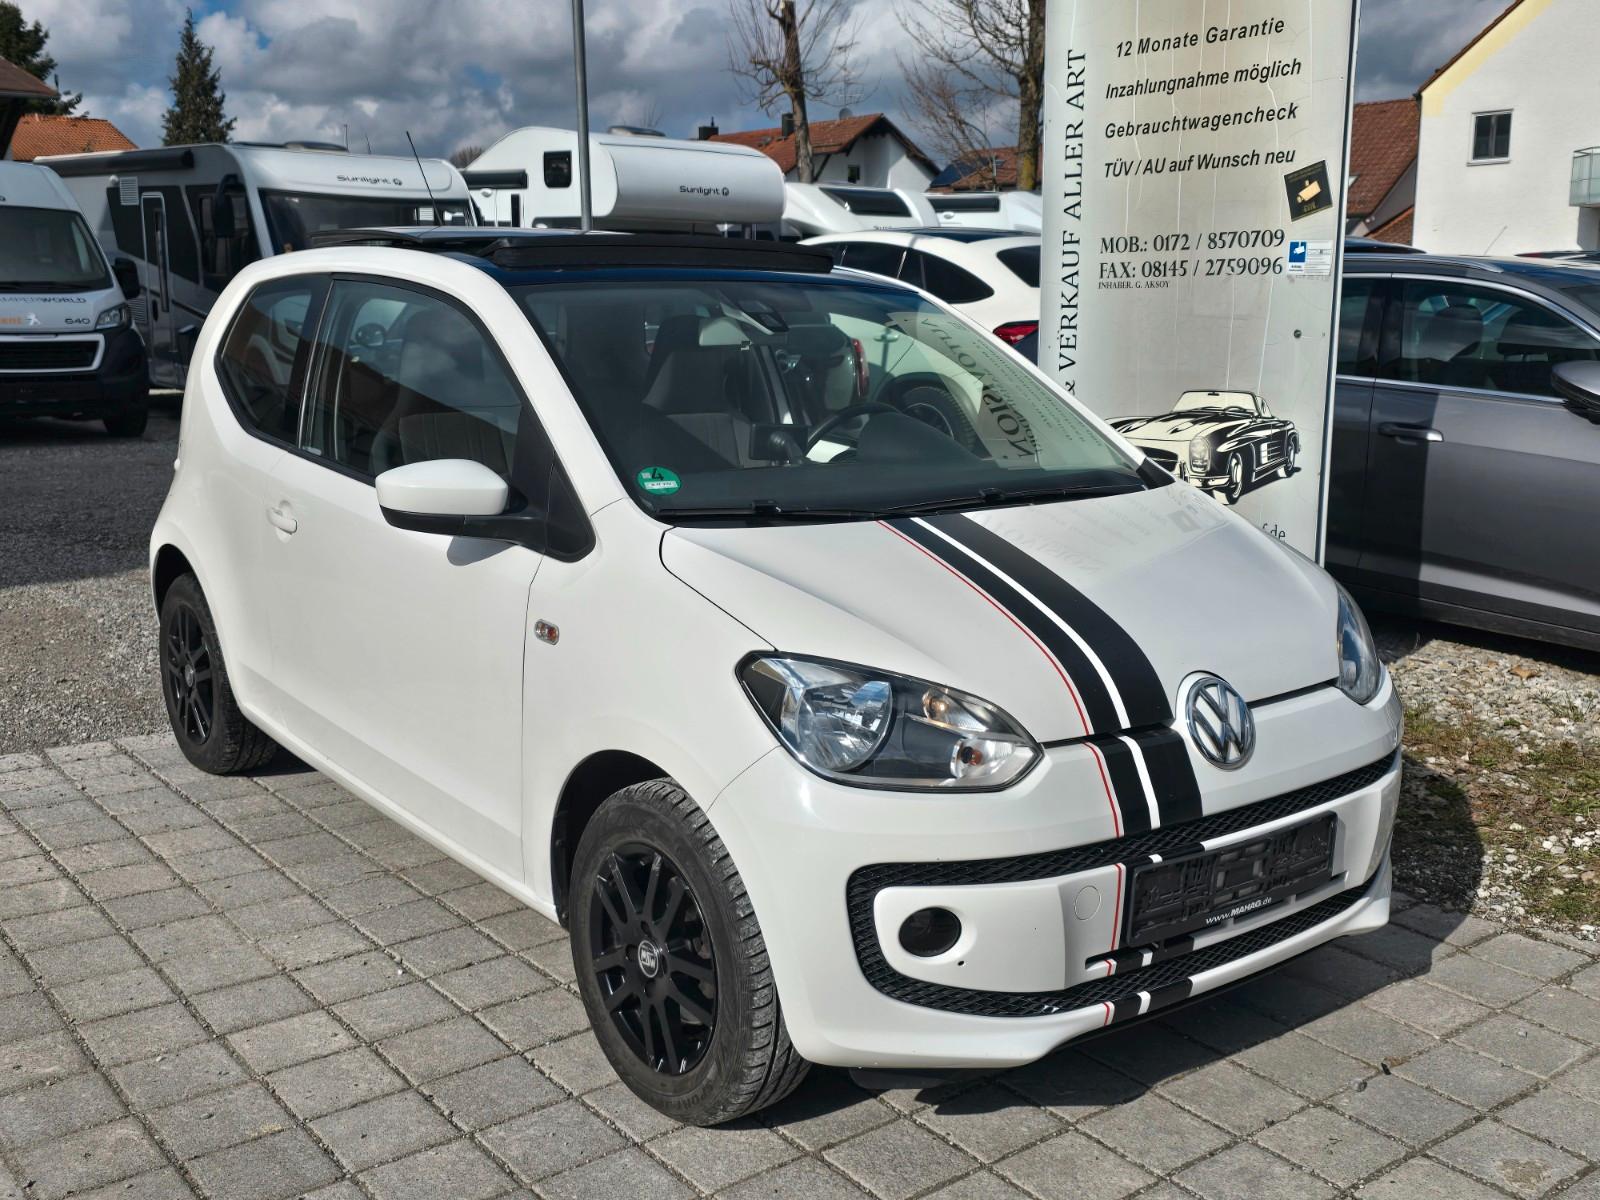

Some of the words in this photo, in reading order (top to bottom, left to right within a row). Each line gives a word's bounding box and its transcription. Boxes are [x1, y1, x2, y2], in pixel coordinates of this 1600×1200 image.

[1116, 41, 1133, 57] 12
[1137, 32, 1198, 55] Monate
[1206, 17, 1285, 44] Garantie
[1066, 48, 1087, 112] ART
[1105, 68, 1230, 100] Inzahlungnahme
[1233, 58, 1302, 85] möglich
[1105, 102, 1298, 138] Gebrauchtwagencheck
[1063, 119, 1085, 222] ALLER
[1104, 159, 1134, 178] TÜV
[1143, 157, 1167, 175] AU
[1169, 154, 1193, 172] auf
[1197, 149, 1260, 171] Wunsch
[1265, 148, 1296, 164] neu
[680, 184, 721, 196] Sunlight
[1099, 237, 1148, 255] MOB.:
[1153, 233, 1191, 252] 0172
[1207, 229, 1286, 250] 8570709
[1099, 261, 1137, 280] FAX:
[1141, 259, 1188, 278] 08145
[1205, 256, 1284, 277] 2759096
[1145, 279, 1170, 289] AKSOY
[1058, 229, 1081, 372] VERKAUF
[651, 467, 664, 480] 4
